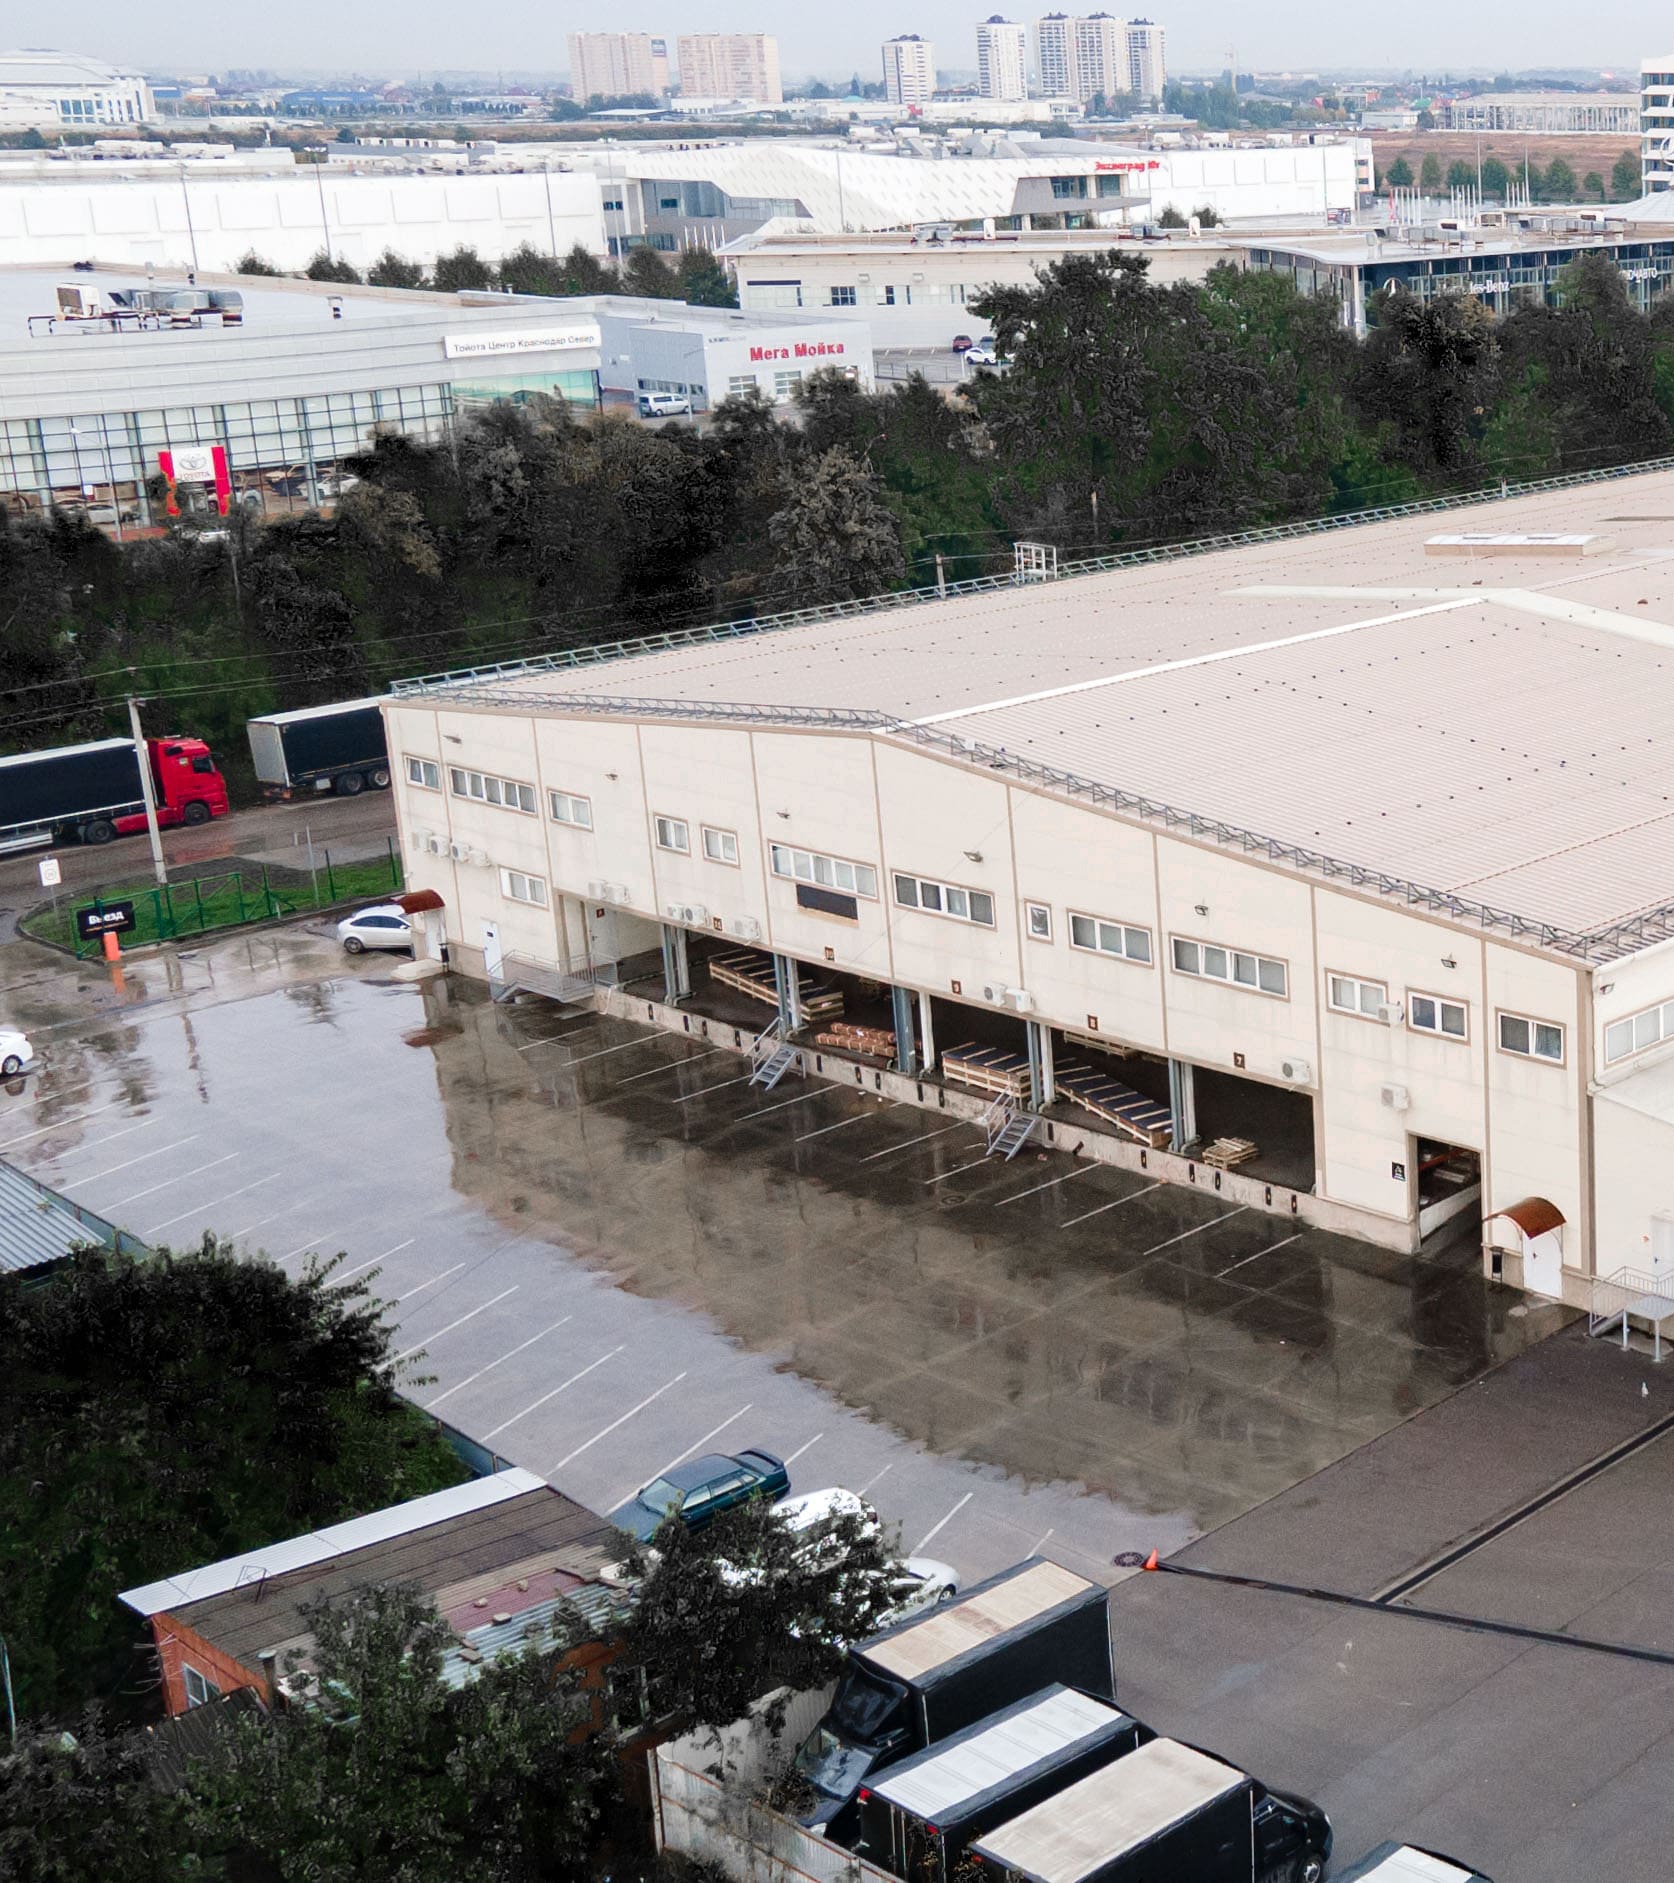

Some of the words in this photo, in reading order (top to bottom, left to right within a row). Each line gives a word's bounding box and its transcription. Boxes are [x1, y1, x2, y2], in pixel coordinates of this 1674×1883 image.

[453, 343, 486, 353] Тойота
[488, 341, 516, 351] Центр
[518, 338, 566, 348] Краснодар
[750, 346, 790, 361] Мега
[794, 342, 844, 357] Мойка
